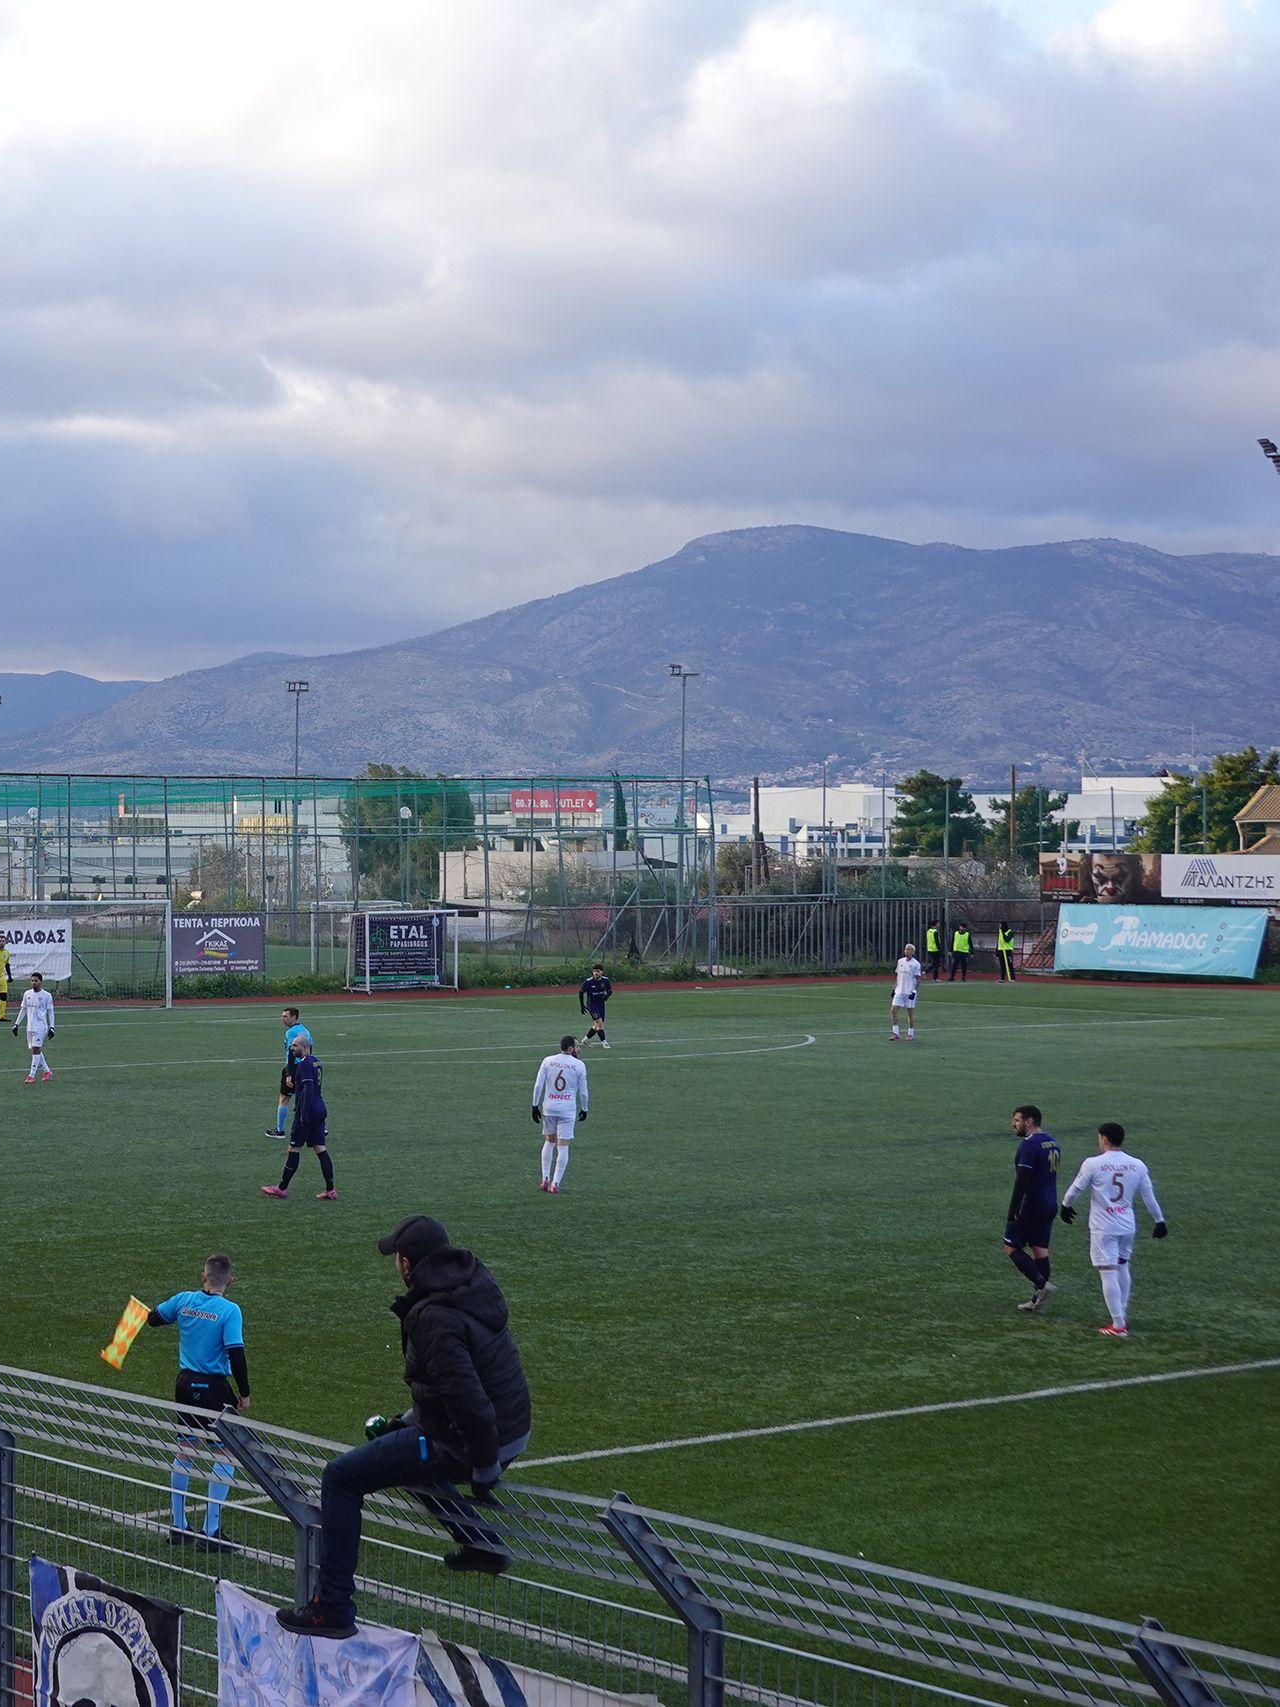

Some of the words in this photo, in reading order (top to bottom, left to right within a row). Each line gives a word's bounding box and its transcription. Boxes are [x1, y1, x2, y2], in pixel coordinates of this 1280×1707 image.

[173, 918, 203, 928] ΤΕΝΤΑ
[211, 917, 260, 928] ΠΕΡΓΚΟΛΑ
[390, 925, 428, 939] ETAL
[1125, 930, 1209, 950] MAMADOG
[205, 940, 228, 948] ΓΚΙΚΑΣ
[554, 1069, 567, 1092] 6
[1110, 1173, 1124, 1202] 5
